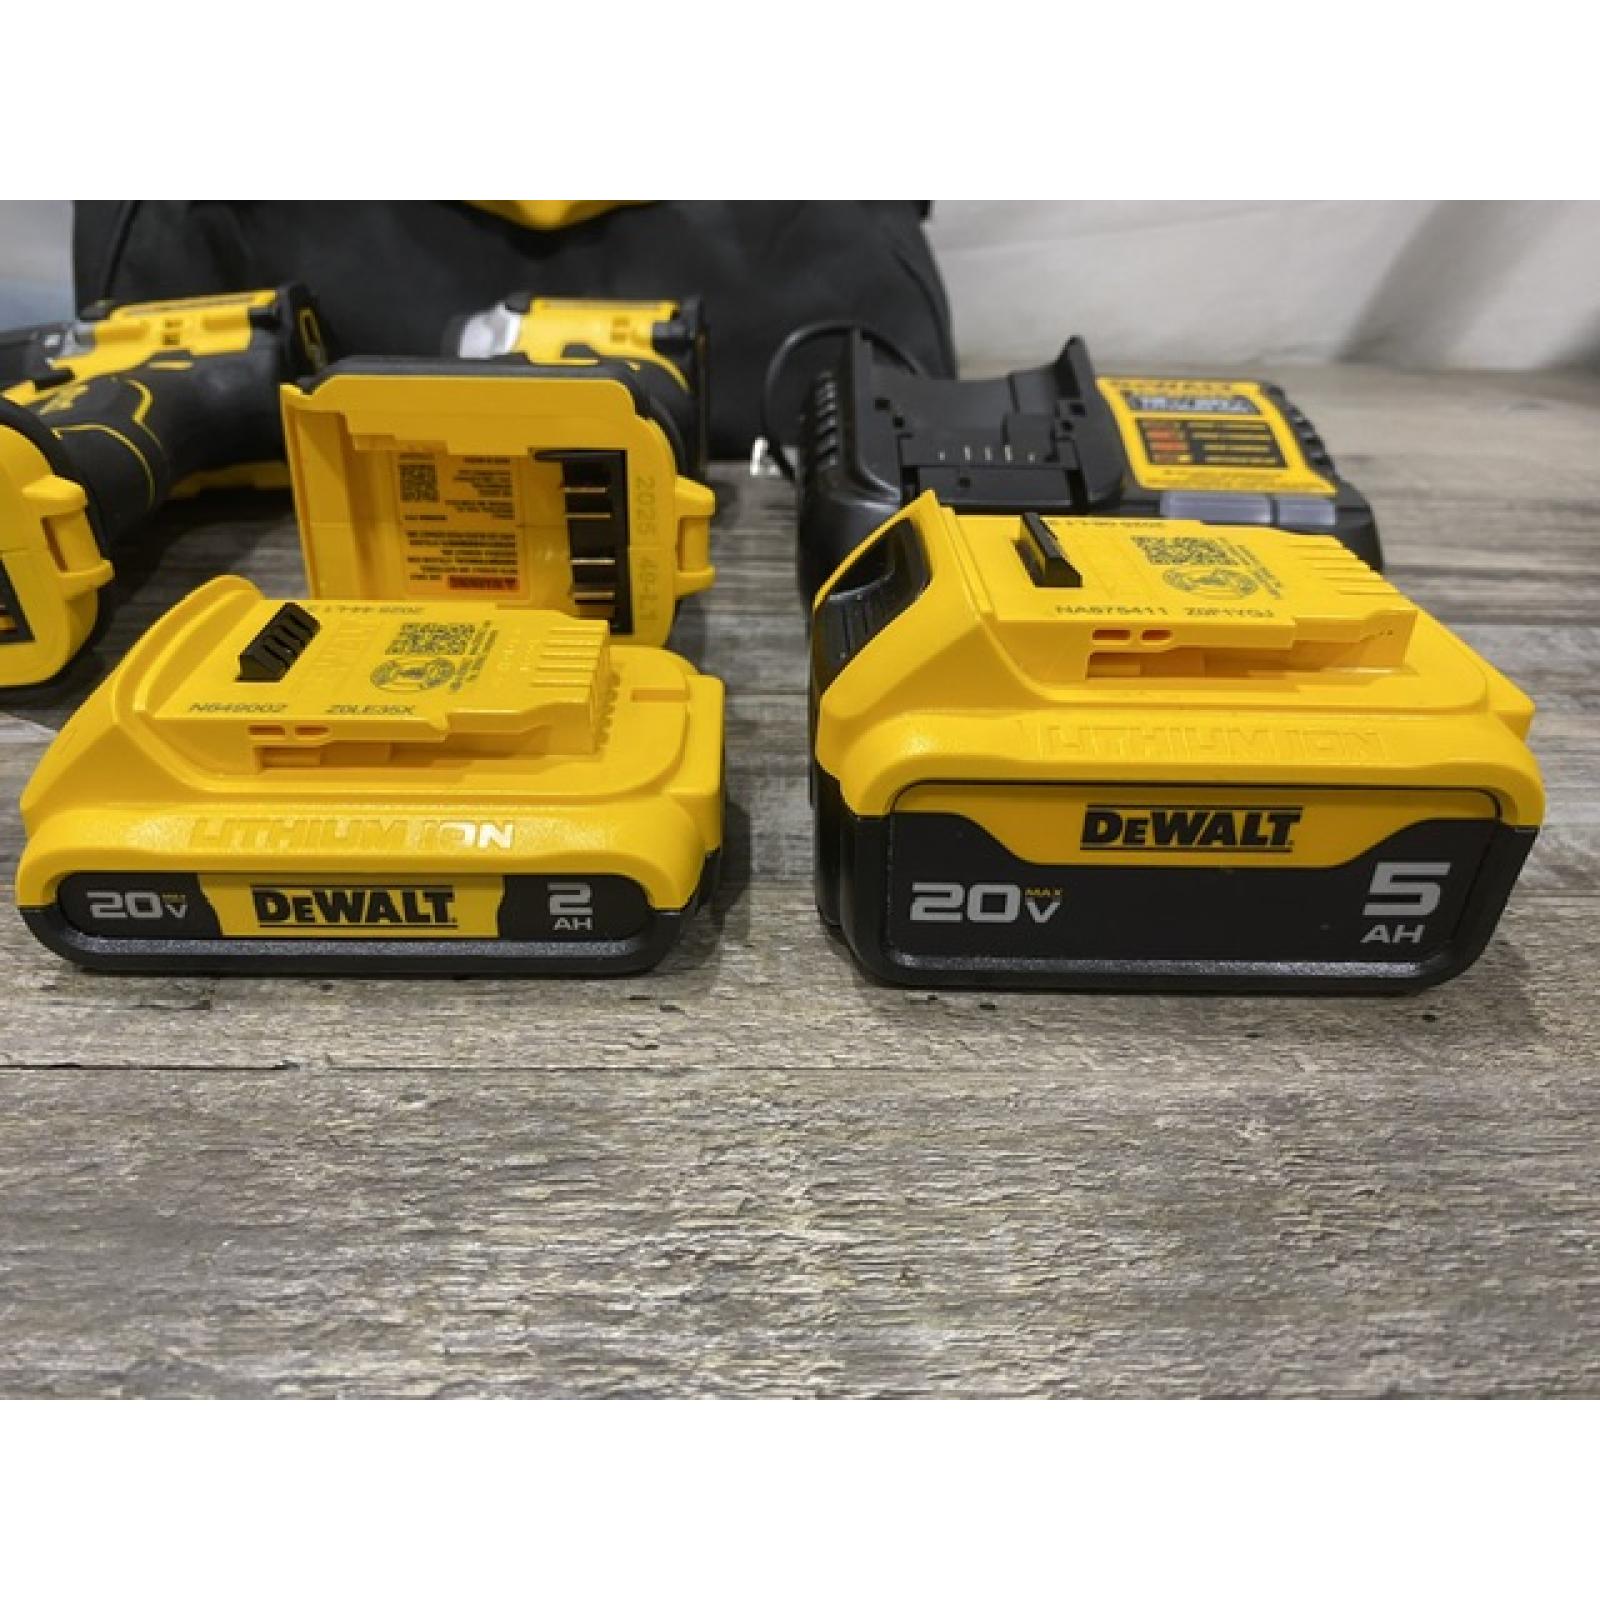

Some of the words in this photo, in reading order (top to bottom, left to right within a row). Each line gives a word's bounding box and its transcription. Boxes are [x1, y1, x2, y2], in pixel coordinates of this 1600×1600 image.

[1046, 725, 1277, 762] LITHIUM
[190, 817, 409, 849] LITHIUM
[417, 818, 515, 850] ION
[547, 882, 593, 916] 2
[1362, 861, 1451, 916] 5
[552, 917, 593, 931] AH
[1360, 924, 1424, 943] AH
